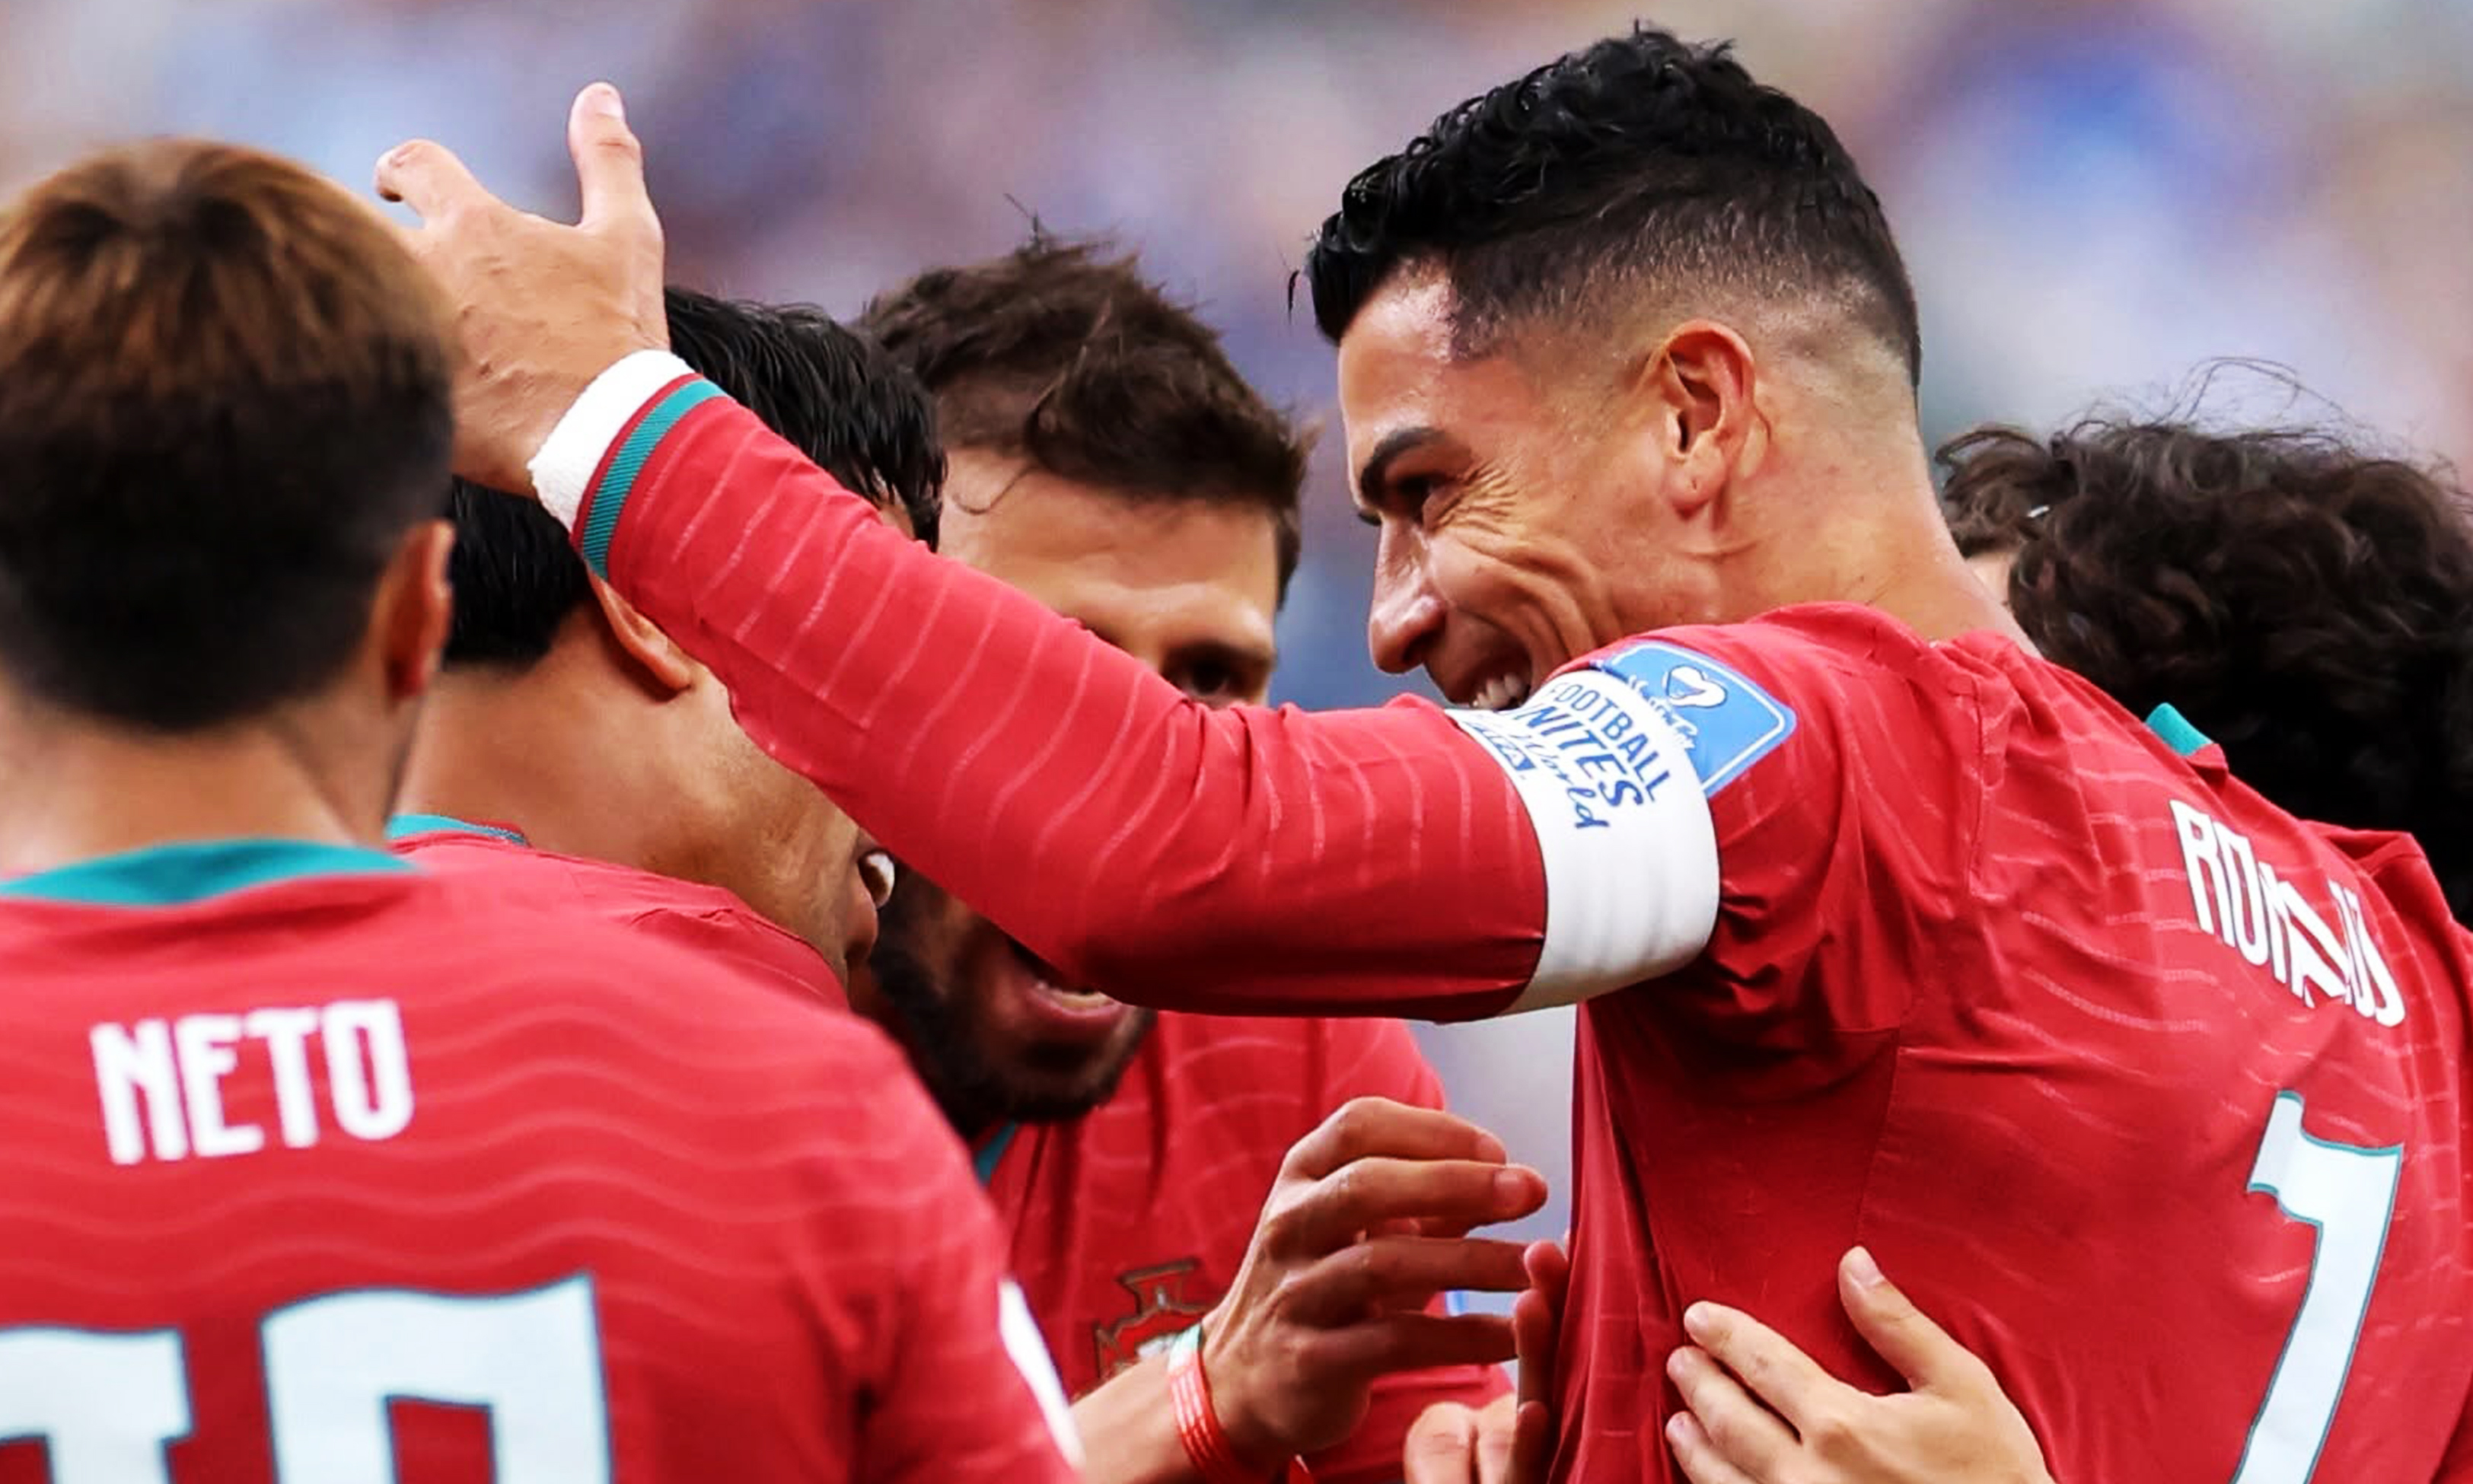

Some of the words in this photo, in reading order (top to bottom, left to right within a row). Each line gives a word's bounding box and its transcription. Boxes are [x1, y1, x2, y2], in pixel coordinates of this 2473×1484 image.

[1513, 705, 1644, 807] NITES
[1544, 682, 1671, 803] FOOTBALL
[2169, 799, 2406, 1027] RONDO
[89, 998, 414, 1164] NETO
[2234, 1090, 2404, 1484] 7
